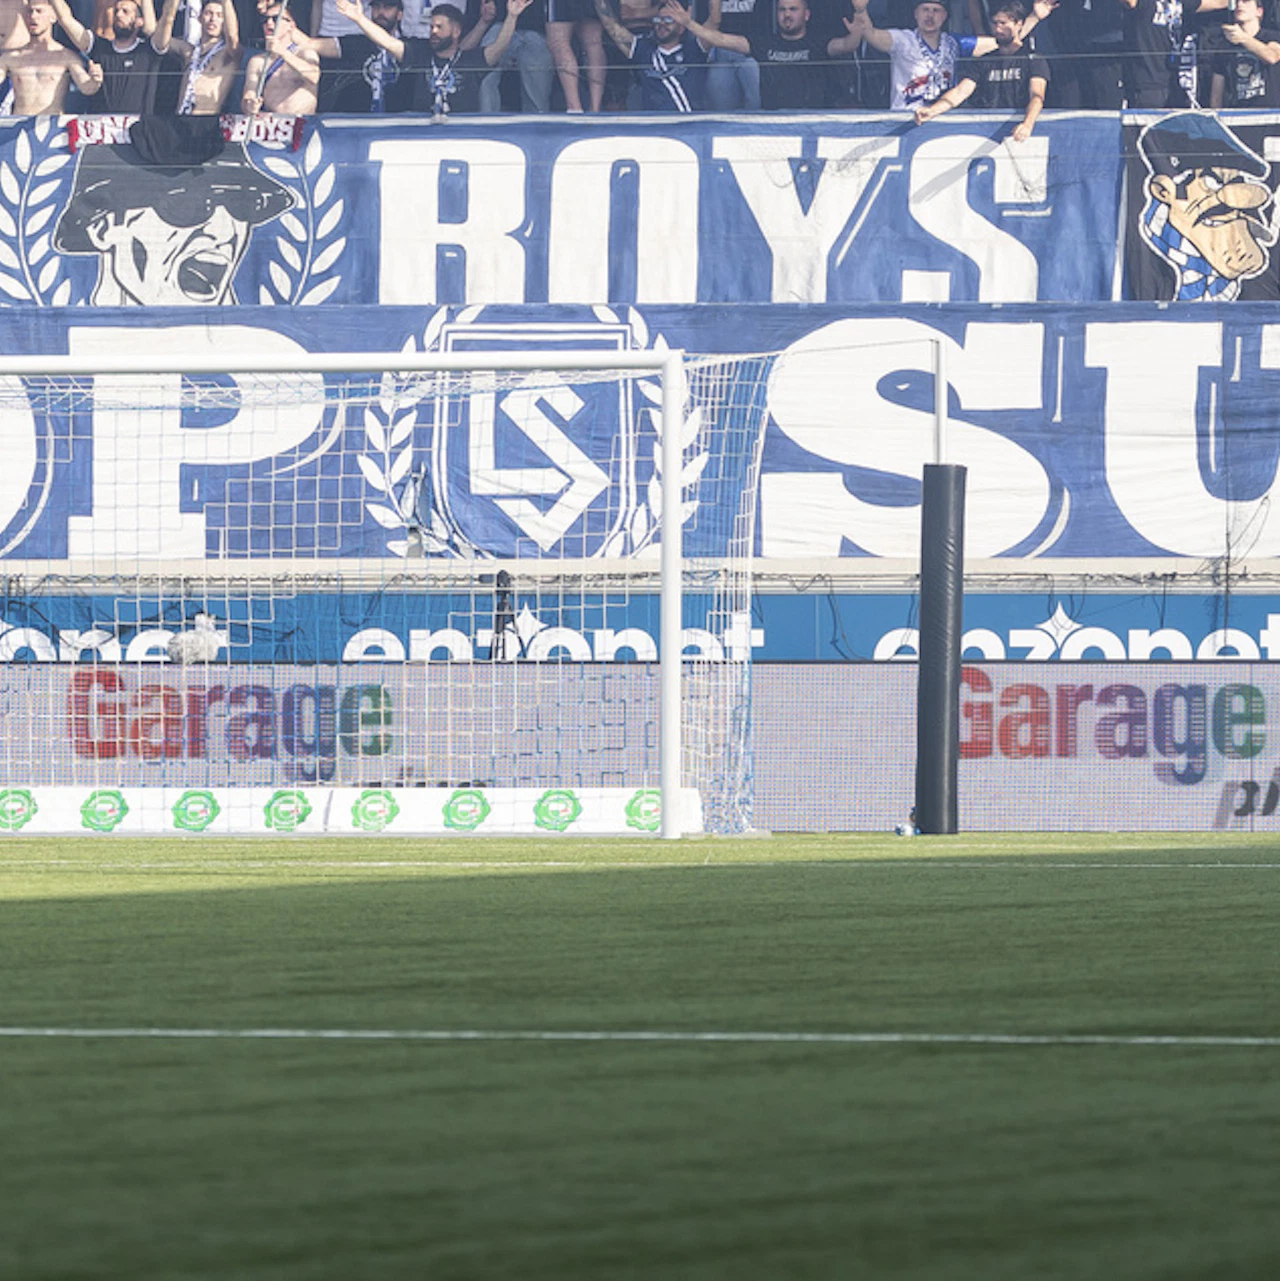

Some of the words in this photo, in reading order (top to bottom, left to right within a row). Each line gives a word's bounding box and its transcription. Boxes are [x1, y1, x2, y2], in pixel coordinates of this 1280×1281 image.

[369, 134, 1051, 304] BOYS
[67, 669, 394, 783] Garage
[958, 666, 1267, 785] Garage
